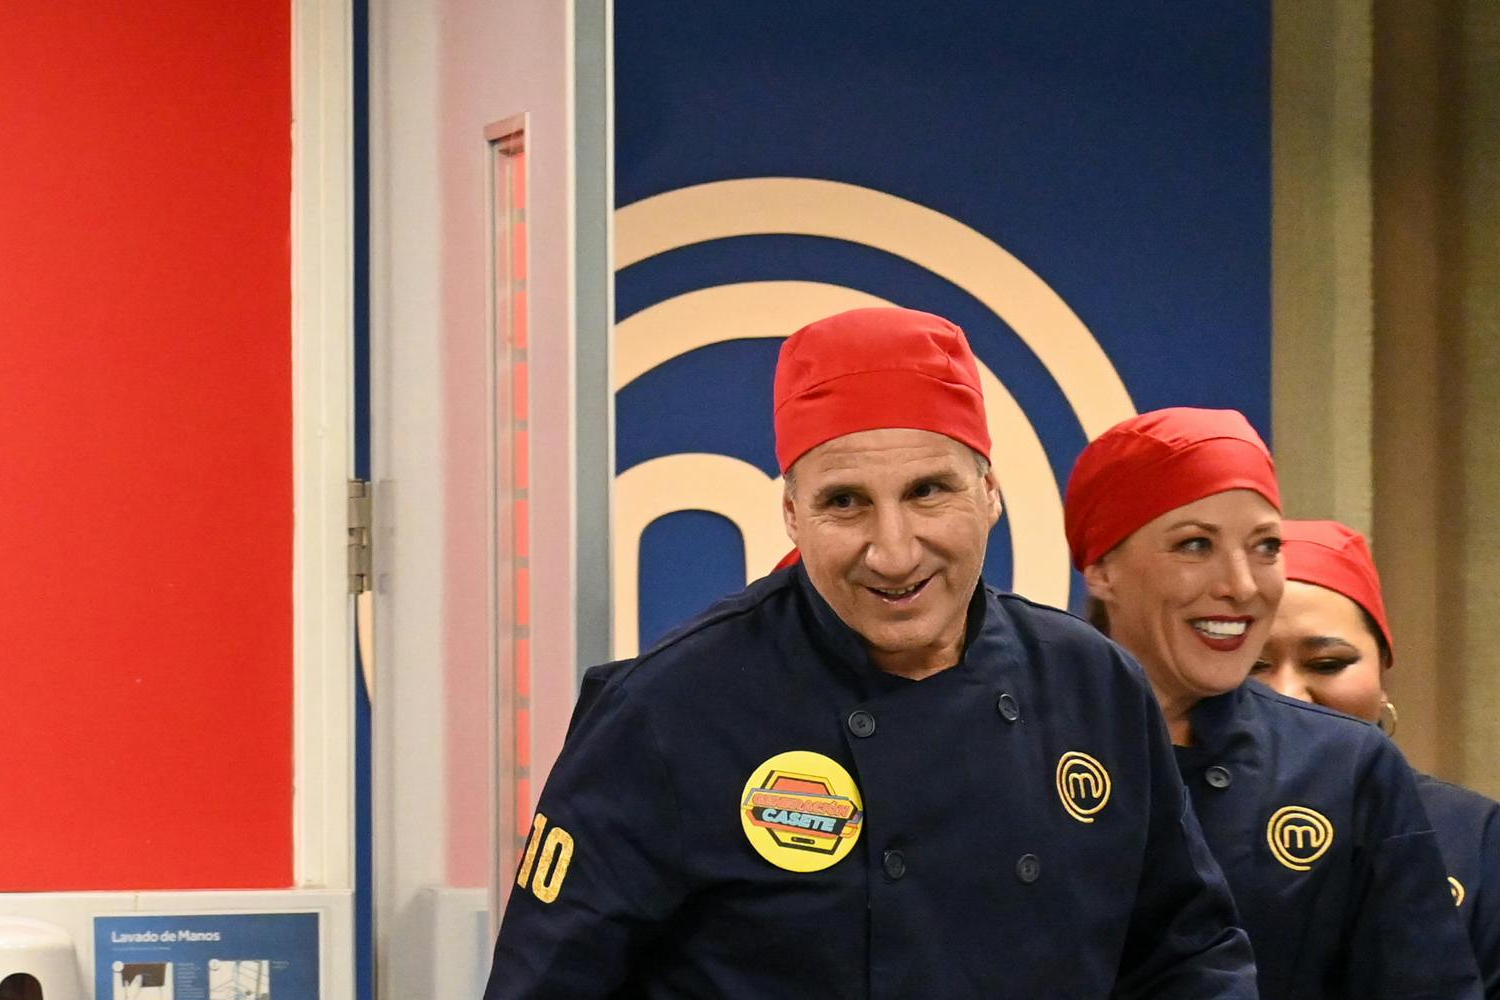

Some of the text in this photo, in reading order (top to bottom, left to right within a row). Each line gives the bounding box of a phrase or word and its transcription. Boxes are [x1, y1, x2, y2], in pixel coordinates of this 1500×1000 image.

[761, 808, 837, 832] CASETE
[516, 812, 575, 904] 10
[111, 929, 221, 943] Lavado de Manos
